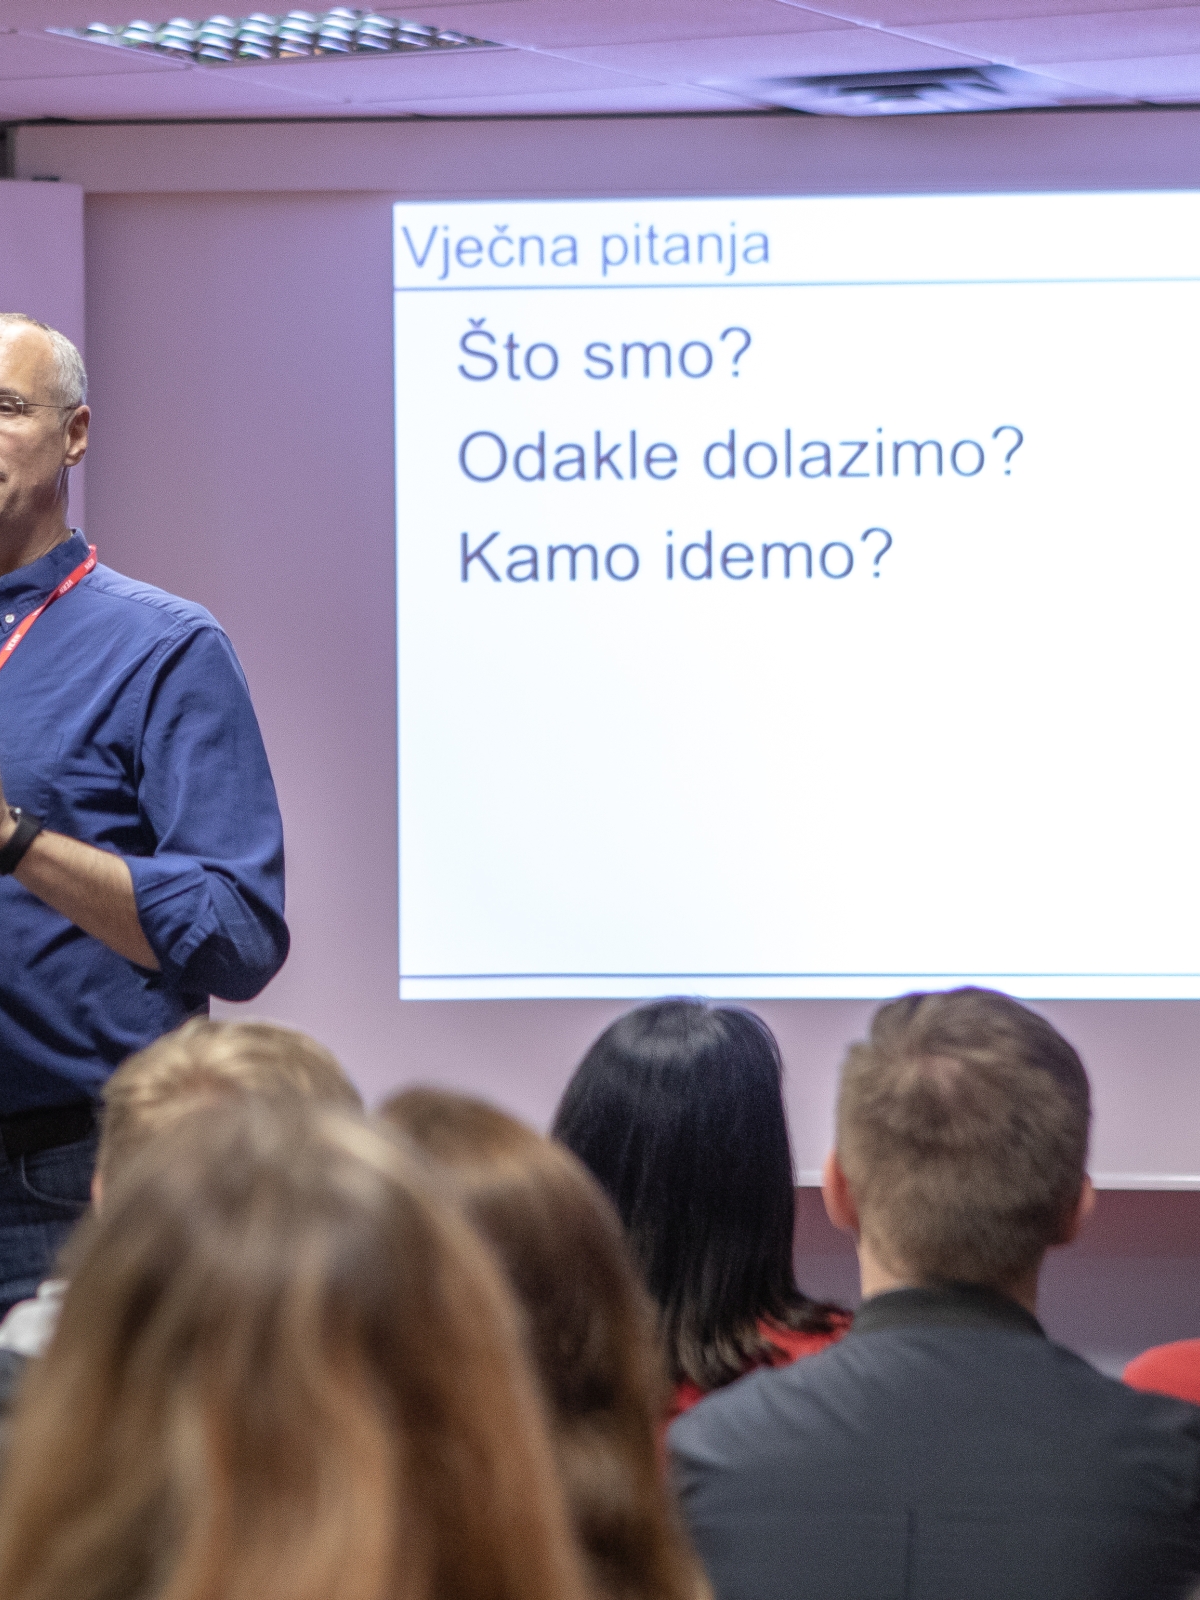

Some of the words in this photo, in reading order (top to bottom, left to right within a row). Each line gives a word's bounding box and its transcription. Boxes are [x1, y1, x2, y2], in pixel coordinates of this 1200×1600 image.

[402, 224, 578, 280] Vječna
[602, 221, 771, 277] pitanja
[458, 317, 560, 382] Što
[584, 326, 753, 380] smo?
[457, 430, 680, 483] Odakle
[702, 425, 1026, 479] dolazimo?
[459, 530, 641, 583] Kamo
[664, 526, 894, 581] idemo?
